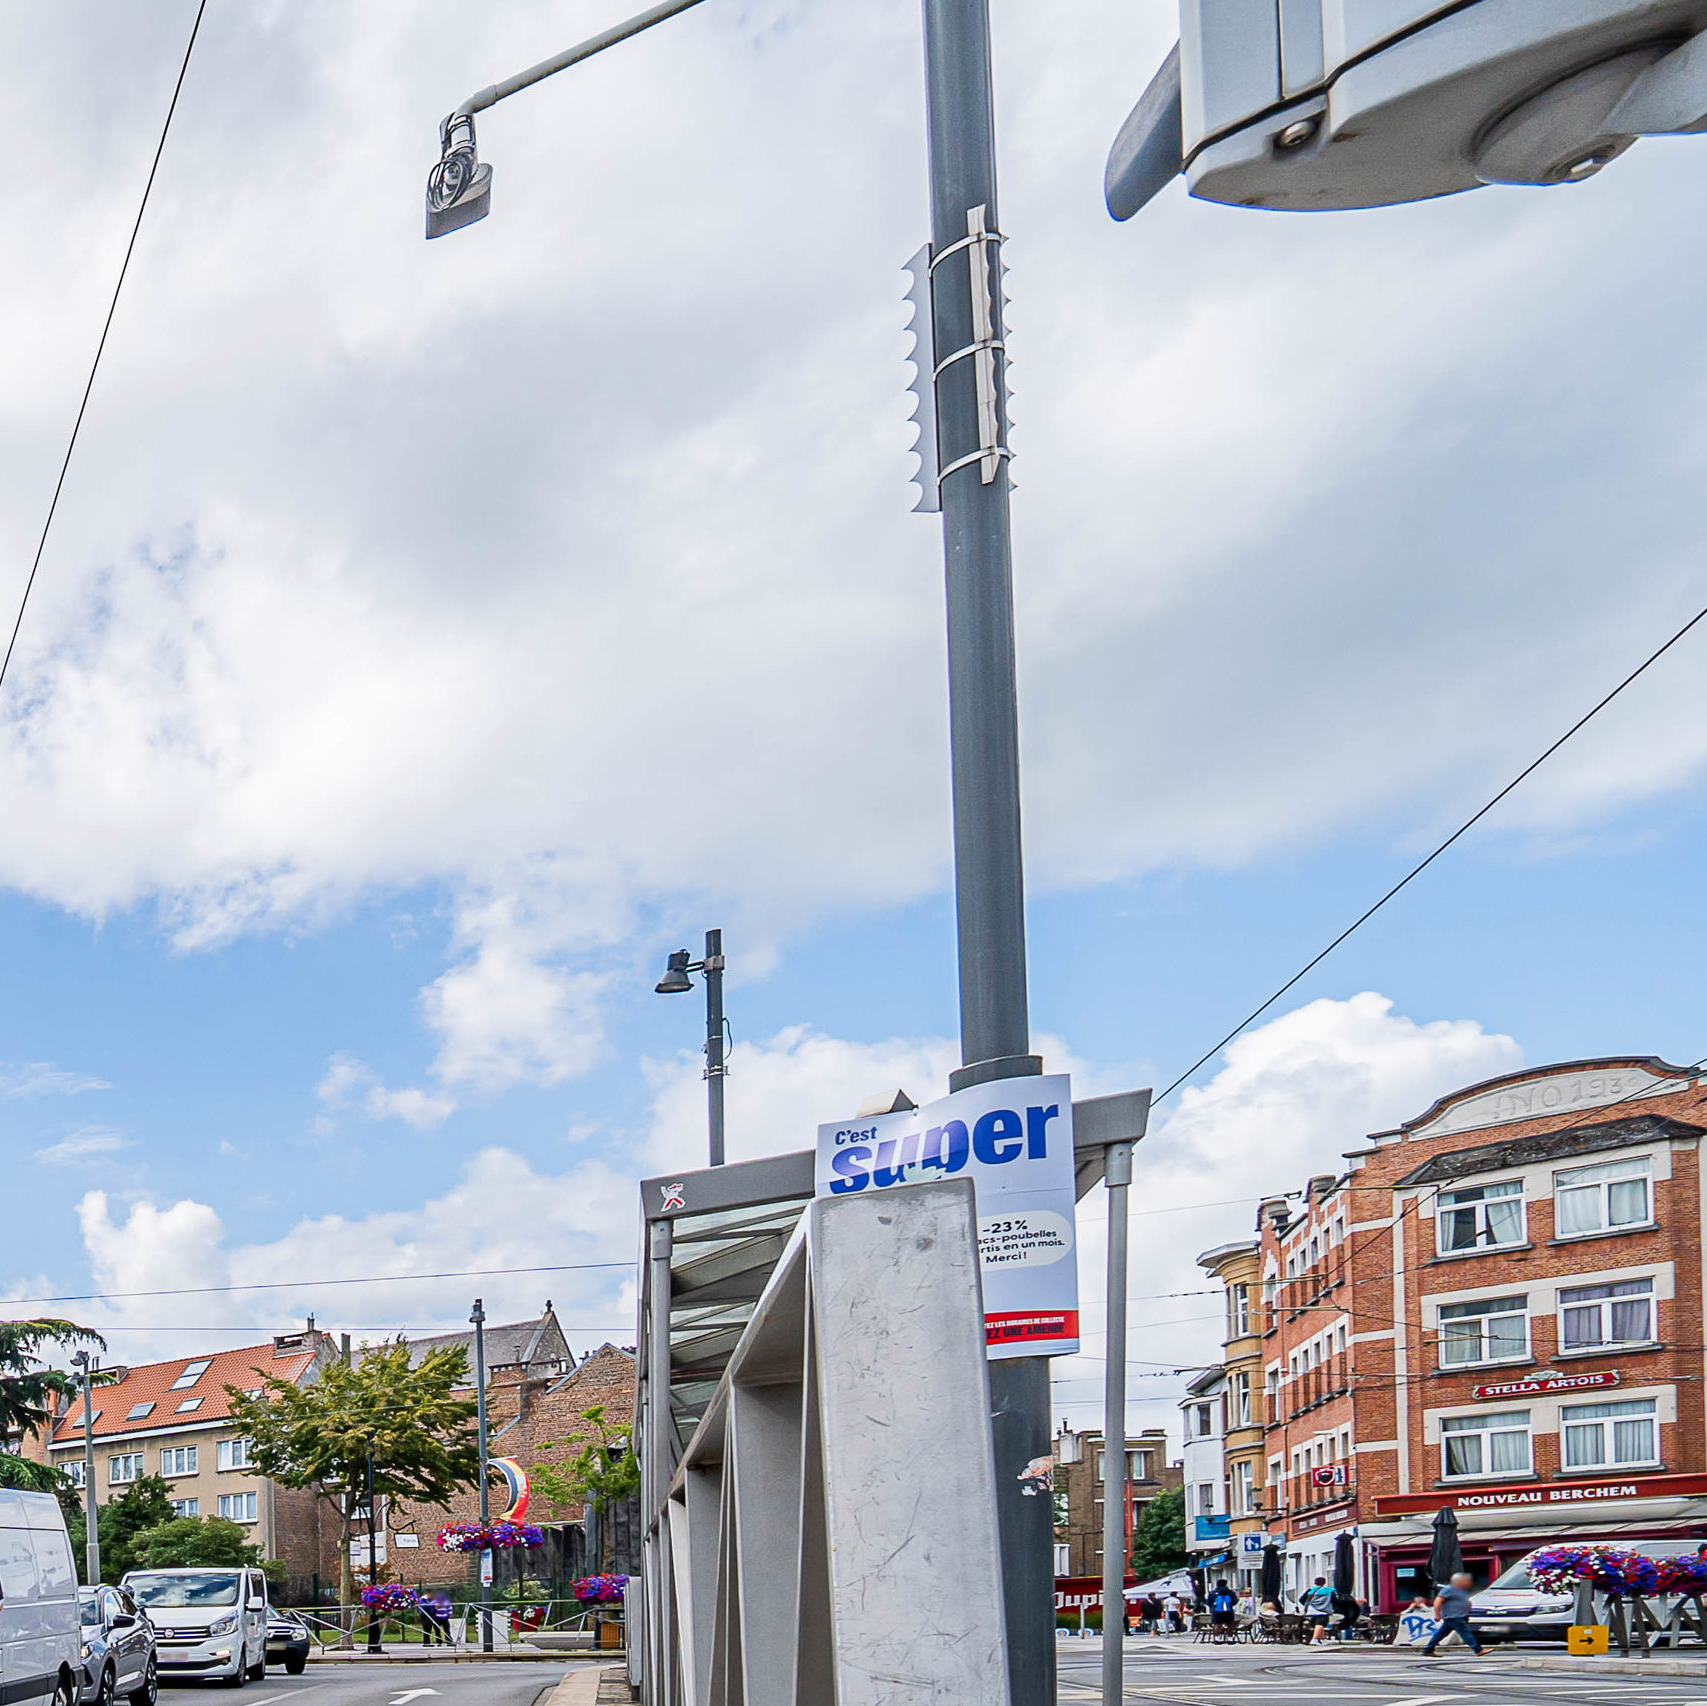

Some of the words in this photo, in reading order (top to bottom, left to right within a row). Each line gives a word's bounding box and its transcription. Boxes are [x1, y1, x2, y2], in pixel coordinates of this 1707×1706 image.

[835, 1126, 877, 1146] C'est
[829, 1104, 1059, 1194] super
[978, 1230, 1057, 1244] acs-poubelles
[980, 1245, 1000, 1253] rtis
[986, 1252, 1021, 1263] Merci
[1004, 1326, 1023, 1337] UNE
[1485, 1382, 1540, 1395] STELLA
[1546, 1375, 1605, 1389] ARTOIS
[1457, 1492, 1542, 1507] NOUVEAU
[1550, 1486, 1637, 1500] BERCHEM
[1052, 1590, 1104, 1610] Jupi
